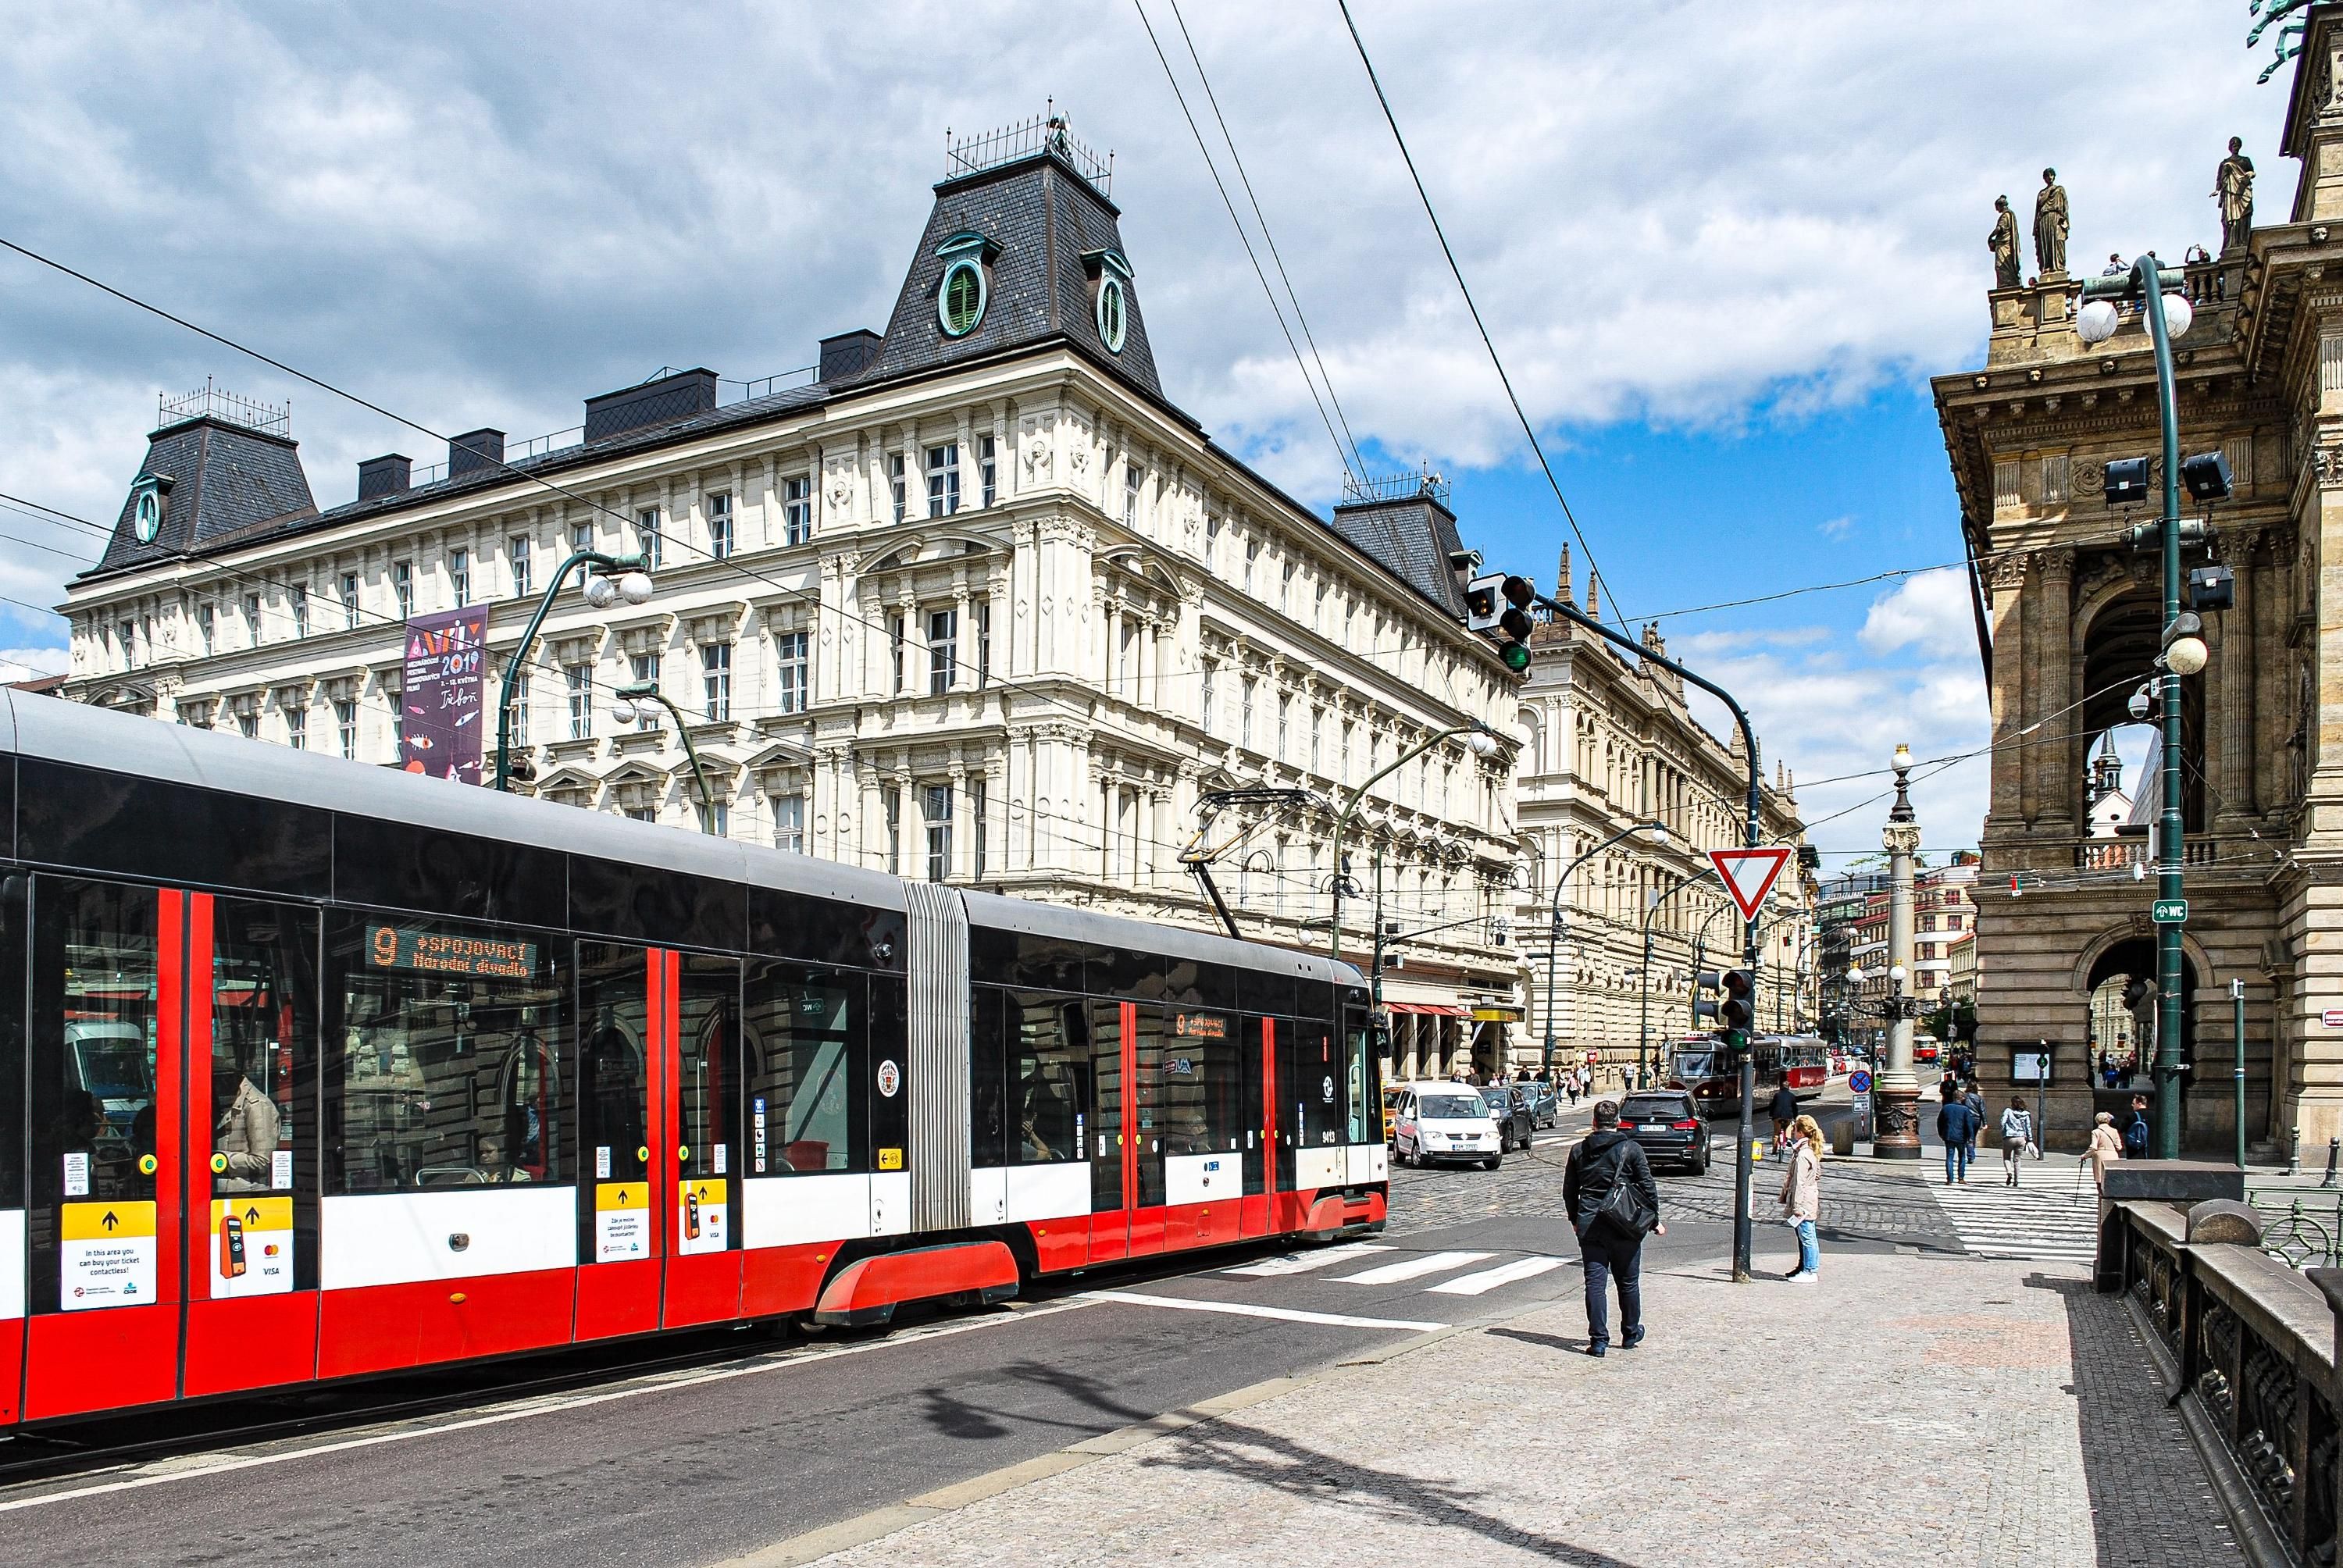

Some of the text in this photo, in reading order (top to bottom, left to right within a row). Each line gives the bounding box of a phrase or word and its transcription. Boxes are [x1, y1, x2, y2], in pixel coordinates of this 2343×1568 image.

[442, 650, 479, 676] 2019
[440, 688, 477, 709] Třeboň
[2168, 906, 2184, 917] WC
[374, 927, 398, 966] 9
[476, 958, 529, 977] divadlo
[1176, 1014, 1186, 1035] 9
[1322, 1131, 1336, 1143] 9413
[90, 1267, 129, 1276] contactless!
